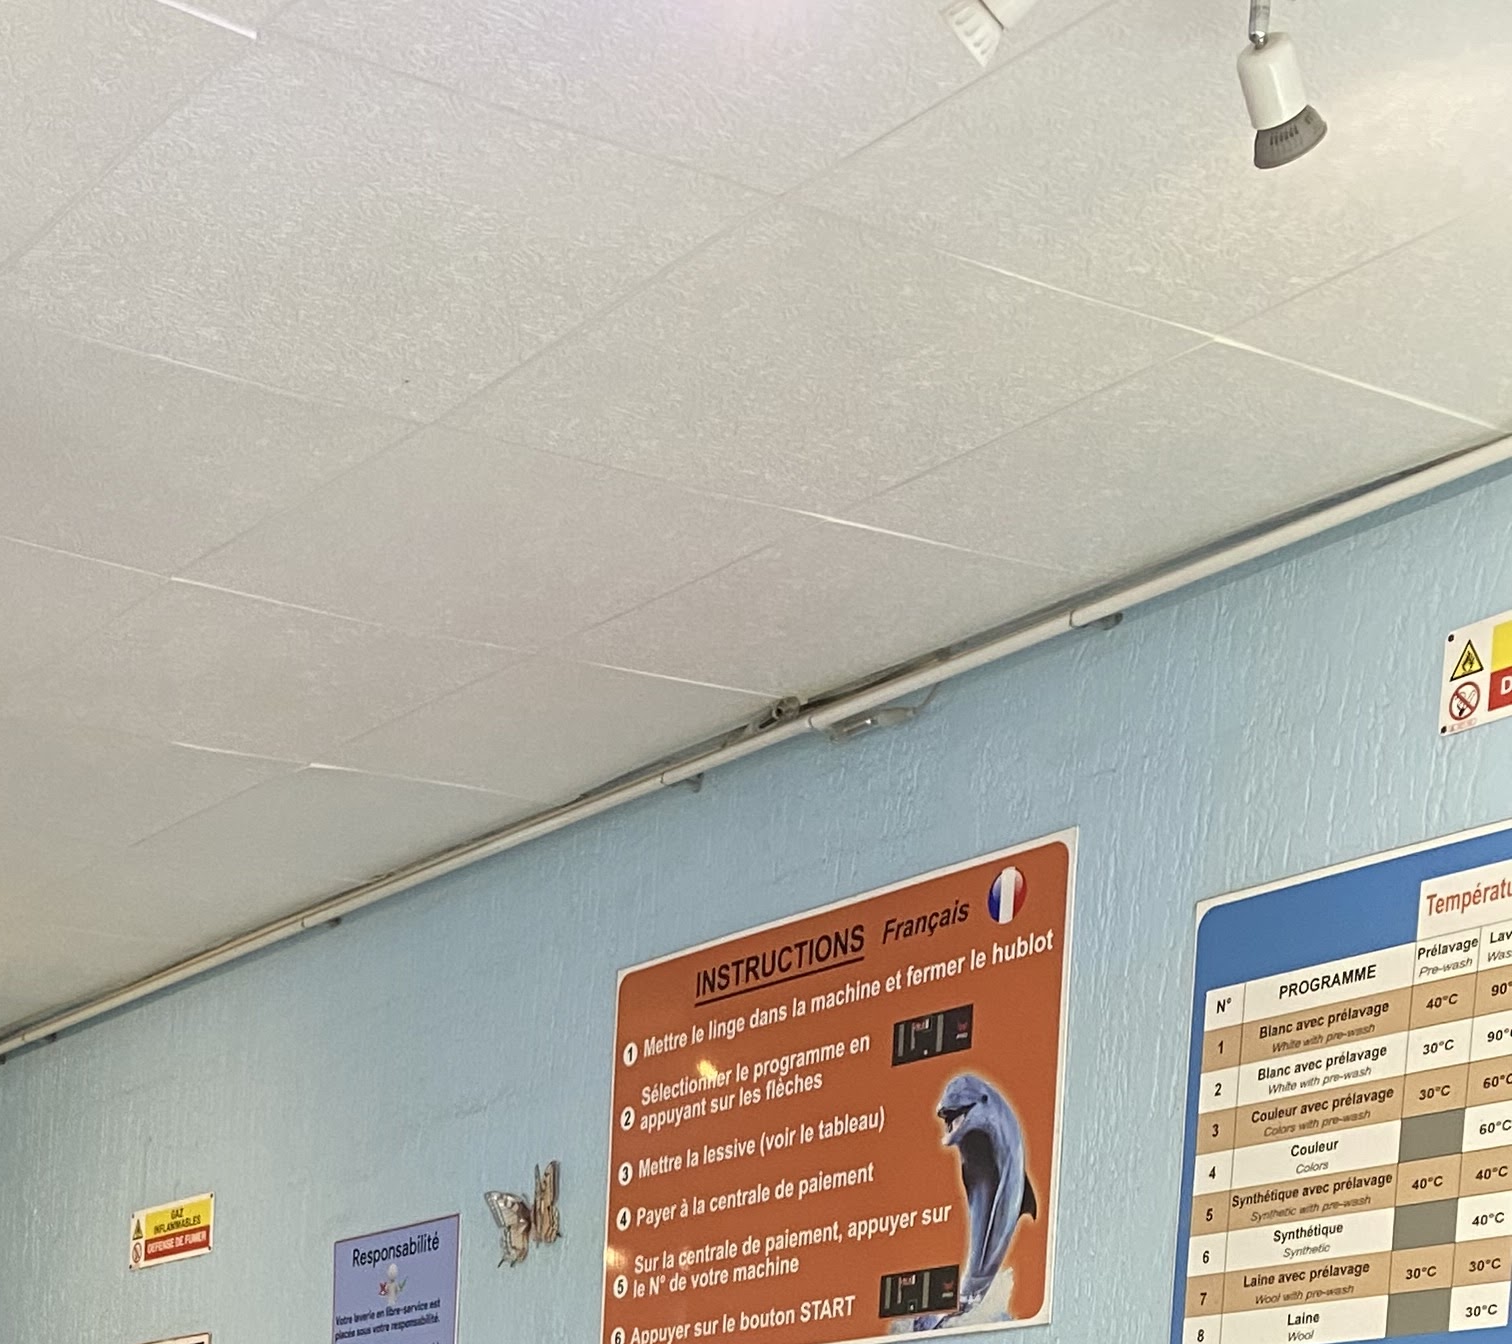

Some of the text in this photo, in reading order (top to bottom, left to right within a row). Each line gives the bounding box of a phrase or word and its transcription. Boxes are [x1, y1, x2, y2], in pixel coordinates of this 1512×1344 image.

[695, 900, 969, 998] INSTRUCTIONS Français
[1417, 937, 1478, 959] Prélavage
[644, 929, 1054, 1058] Mettre le linge dans la machine et fermer le hublot
[1216, 965, 1377, 1014] N° PROGRAMME
[1426, 994, 1458, 1009] 40°C
[1260, 1002, 1389, 1039] Blanc avec prélavage
[1423, 1039, 1454, 1055] 30°C
[642, 1035, 870, 1106] Sélectionner le programme en
[1291, 1139, 1338, 1157] Couleur
[1296, 1161, 1329, 1174] Colors
[171, 1208, 184, 1219] GAZ
[635, 1205, 952, 1273] Sur la centrale de paiement, appuyer sur
[1273, 1223, 1343, 1243] Synthétique
[352, 1232, 439, 1268] Responsabilité
[336, 1315, 352, 1325] Votre
[430, 1299, 440, 1308] est
[694, 1319, 717, 1338] sur
[722, 1314, 734, 1333] le
[740, 1305, 795, 1331] bouton
[800, 1296, 855, 1323] START
[1287, 1313, 1319, 1326] Laine
[1465, 1304, 1498, 1318] 30°C
[357, 1327, 371, 1336] sous
[373, 1323, 389, 1332] votre
[1288, 1330, 1314, 1342] Wool
